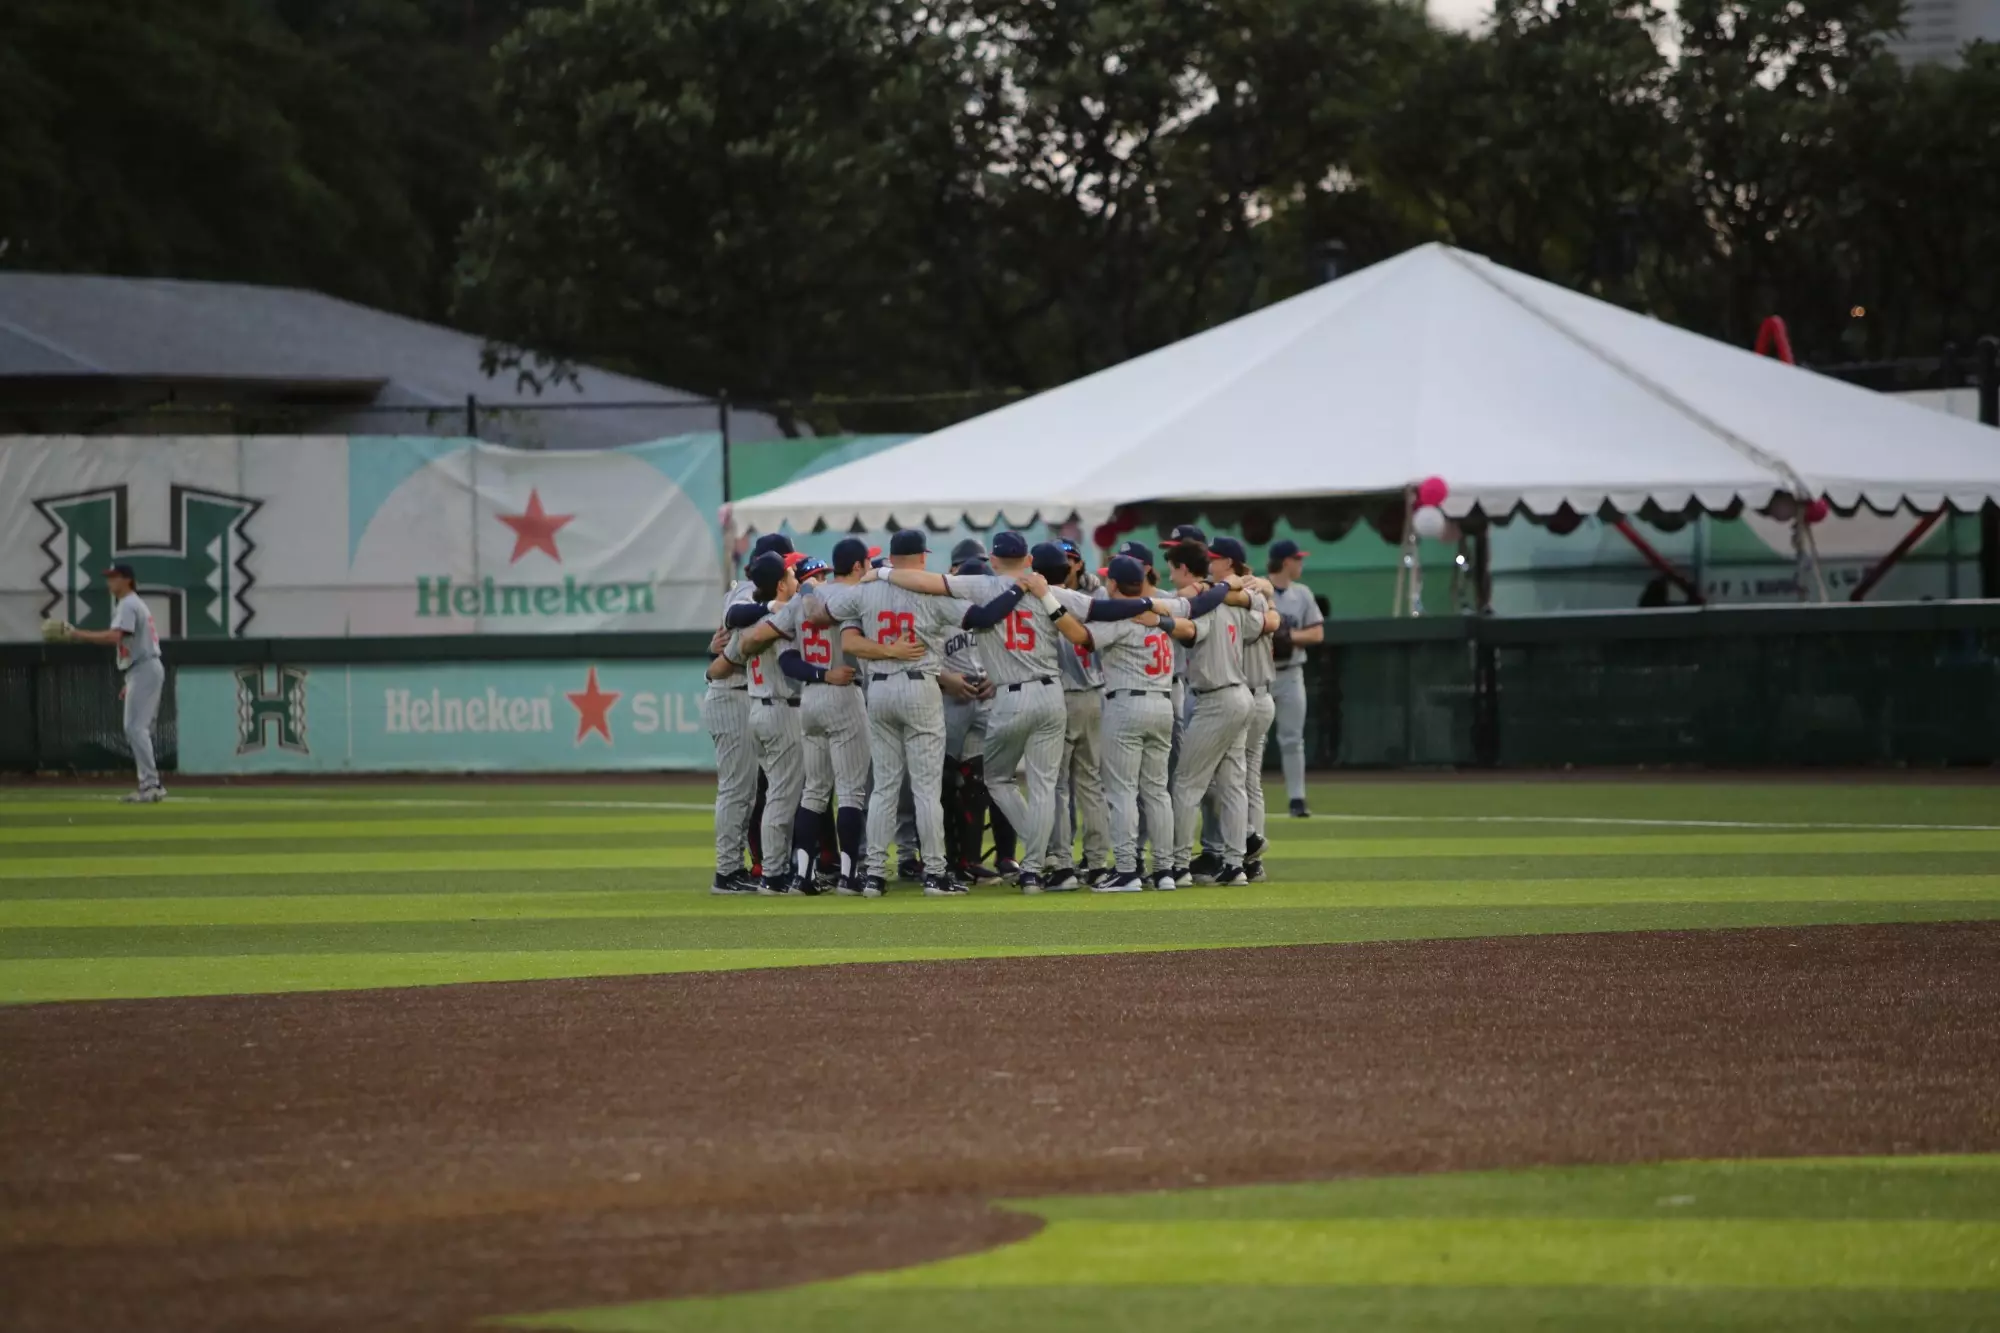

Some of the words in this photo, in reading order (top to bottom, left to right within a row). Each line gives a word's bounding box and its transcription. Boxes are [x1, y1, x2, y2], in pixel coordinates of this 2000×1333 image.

[415, 574, 655, 617] Heineken
[801, 620, 831, 664] 25
[1004, 608, 1035, 652] 15
[384, 688, 554, 733] Heineken
